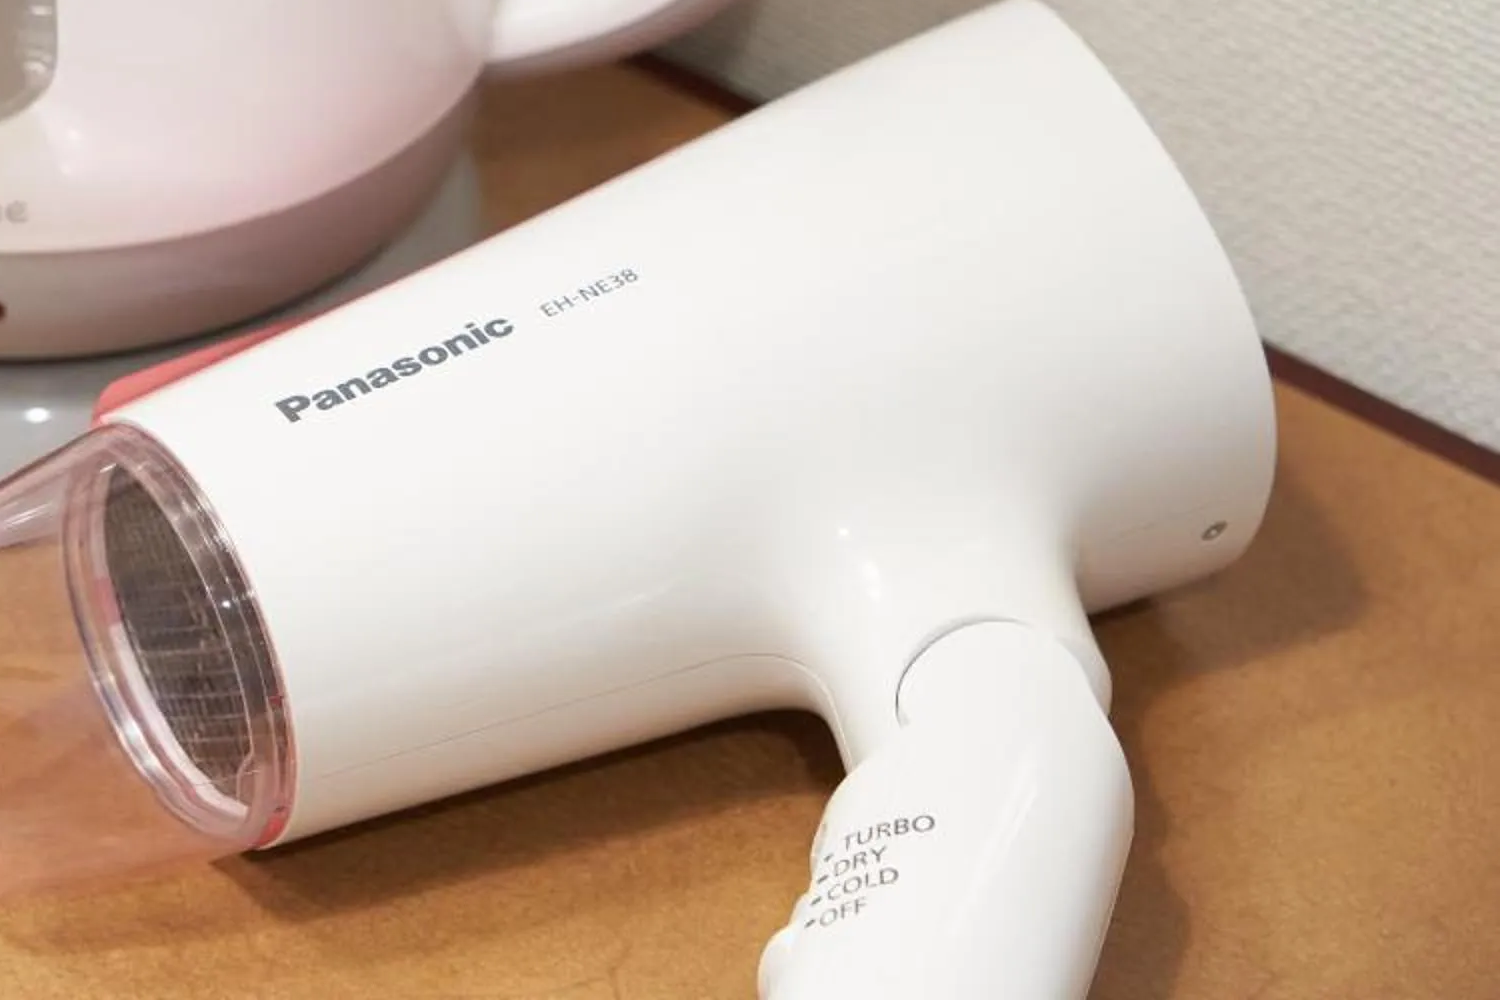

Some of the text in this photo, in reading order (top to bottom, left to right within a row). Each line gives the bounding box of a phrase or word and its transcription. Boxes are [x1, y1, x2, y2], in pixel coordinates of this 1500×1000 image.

[274, 267, 640, 424] Panasonic EH-NE38
[844, 814, 936, 850] TURBO
[833, 846, 888, 877] DRY
[827, 866, 899, 901] COLD
[819, 896, 867, 927] OFF
